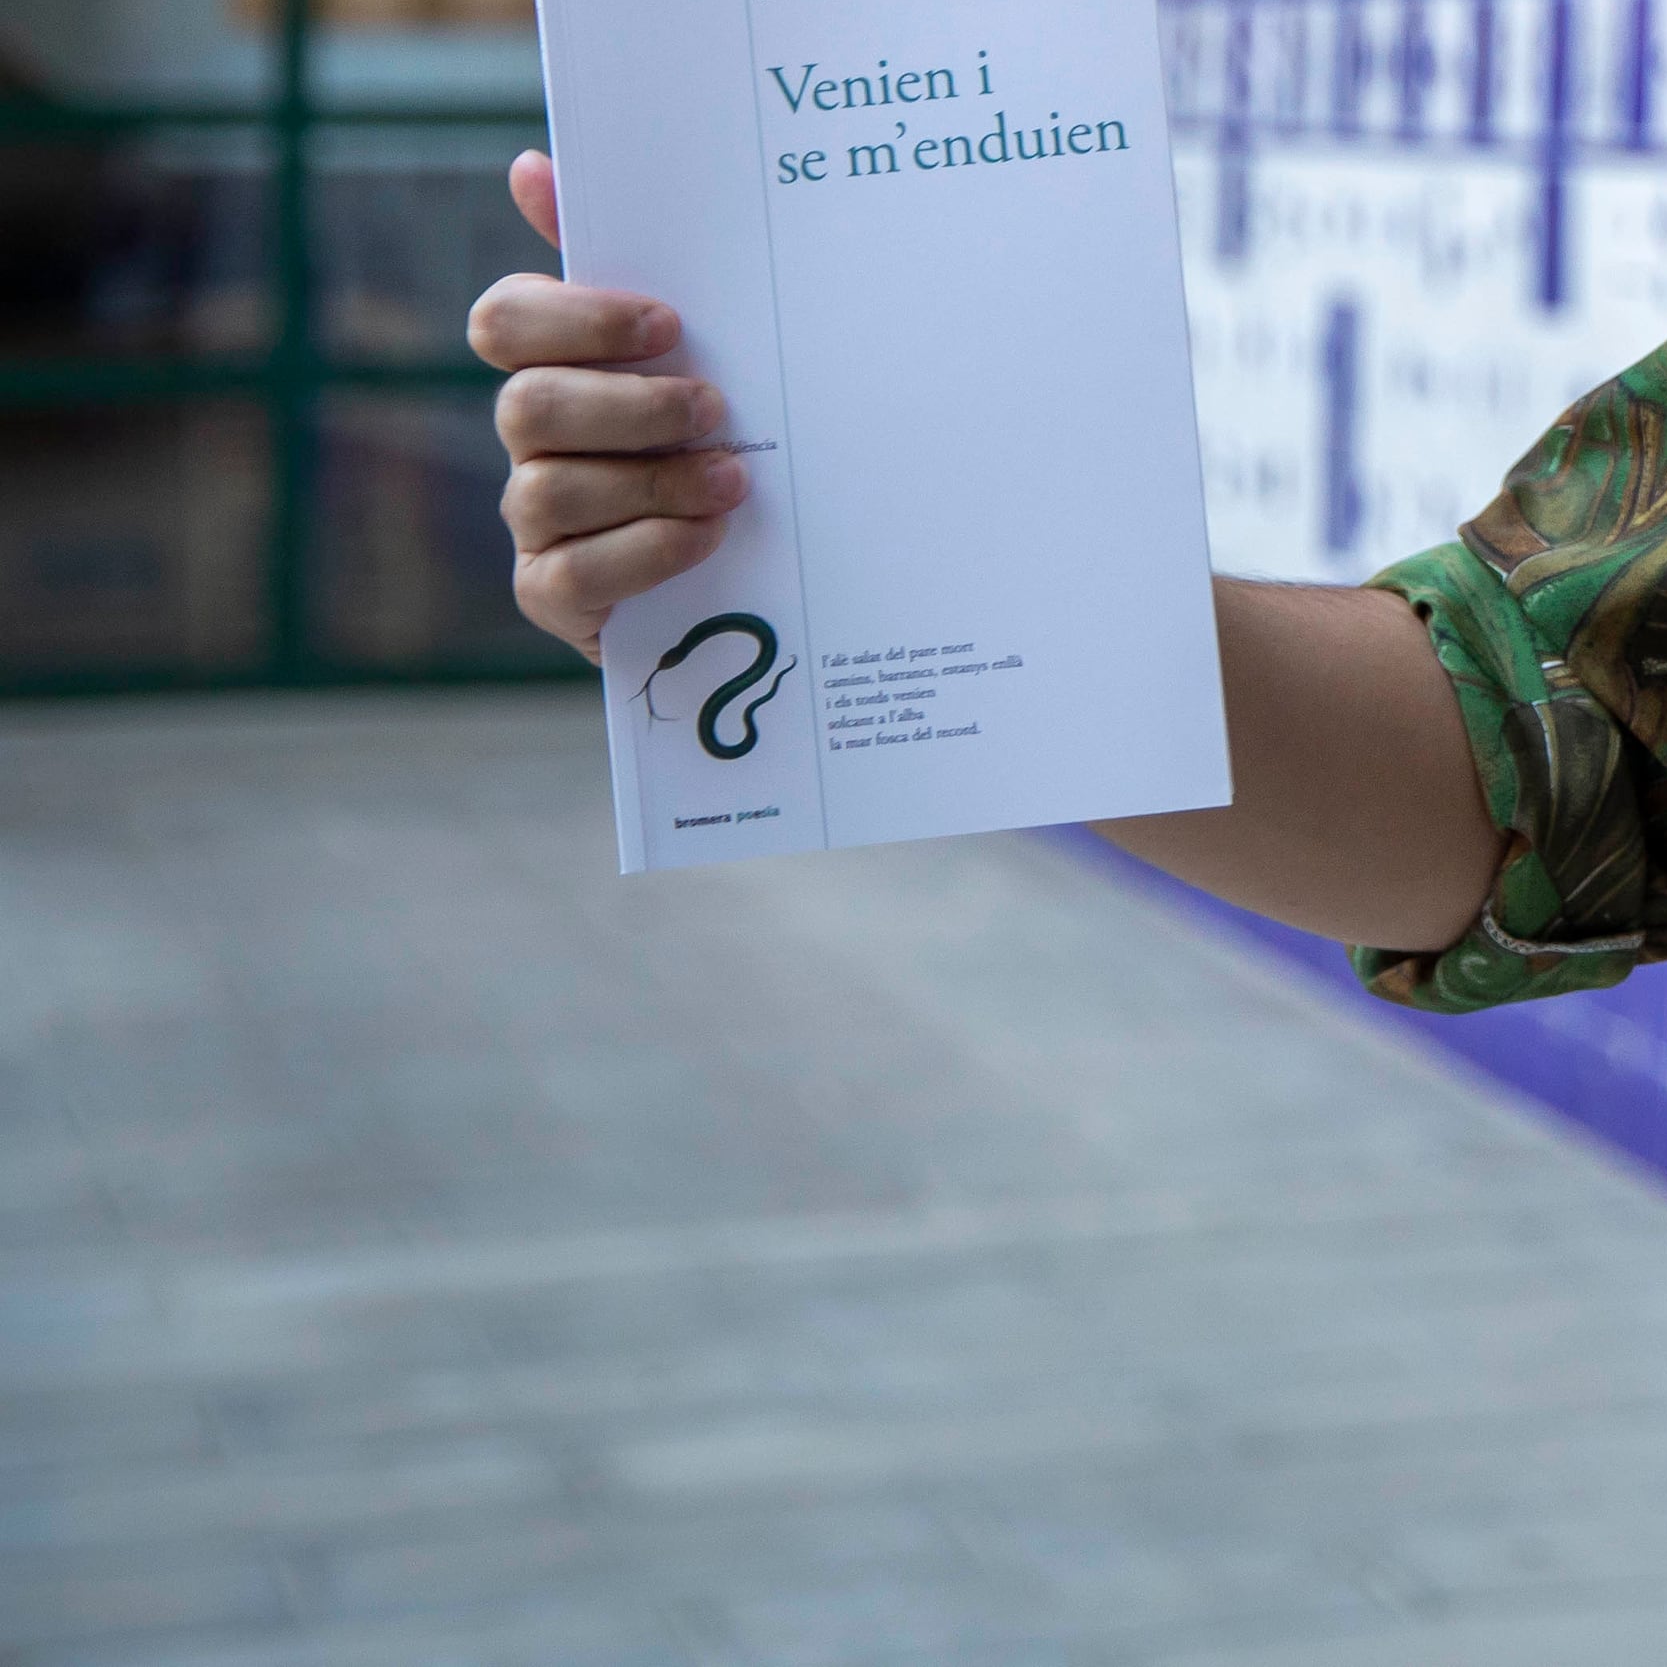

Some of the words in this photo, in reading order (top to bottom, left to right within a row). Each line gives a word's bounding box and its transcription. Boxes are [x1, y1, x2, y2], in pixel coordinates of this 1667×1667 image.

[766, 60, 959, 114] Venien
[978, 50, 994, 95] i
[778, 149, 828, 184] se
[847, 111, 1131, 177] m'enduien
[885, 646, 905, 661] del
[909, 647, 937, 662] pare
[893, 687, 936, 702] venien
[877, 715, 886, 725] a
[829, 737, 842, 752] la
[845, 737, 873, 749] mar
[912, 725, 932, 741] del
[674, 814, 731, 829] bromera
